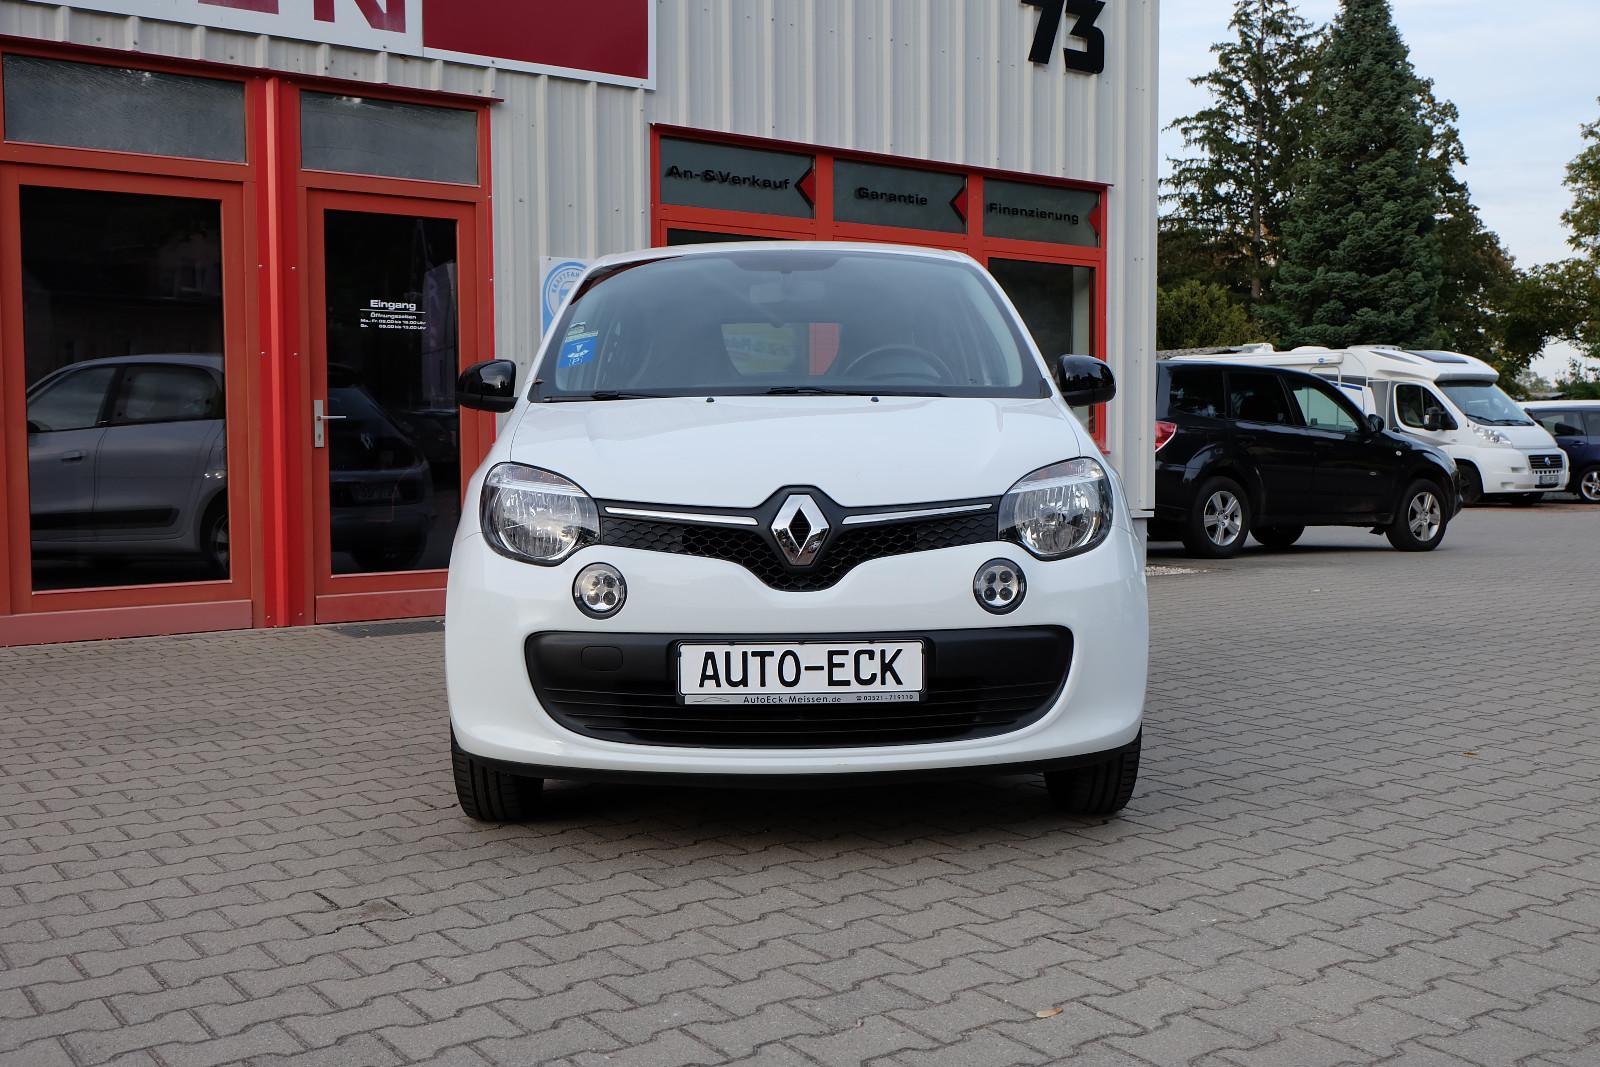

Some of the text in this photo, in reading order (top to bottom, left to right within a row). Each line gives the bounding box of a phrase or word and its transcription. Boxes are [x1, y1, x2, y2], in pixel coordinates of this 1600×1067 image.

[1020, 0, 1105, 74] 73
[857, 187, 928, 206] Garantie
[989, 202, 1079, 225] Finanzierung
[370, 299, 417, 312] Eingang
[698, 648, 904, 688] AUTO-ECK
[743, 695, 842, 705] AutoEck-Meissen.de
